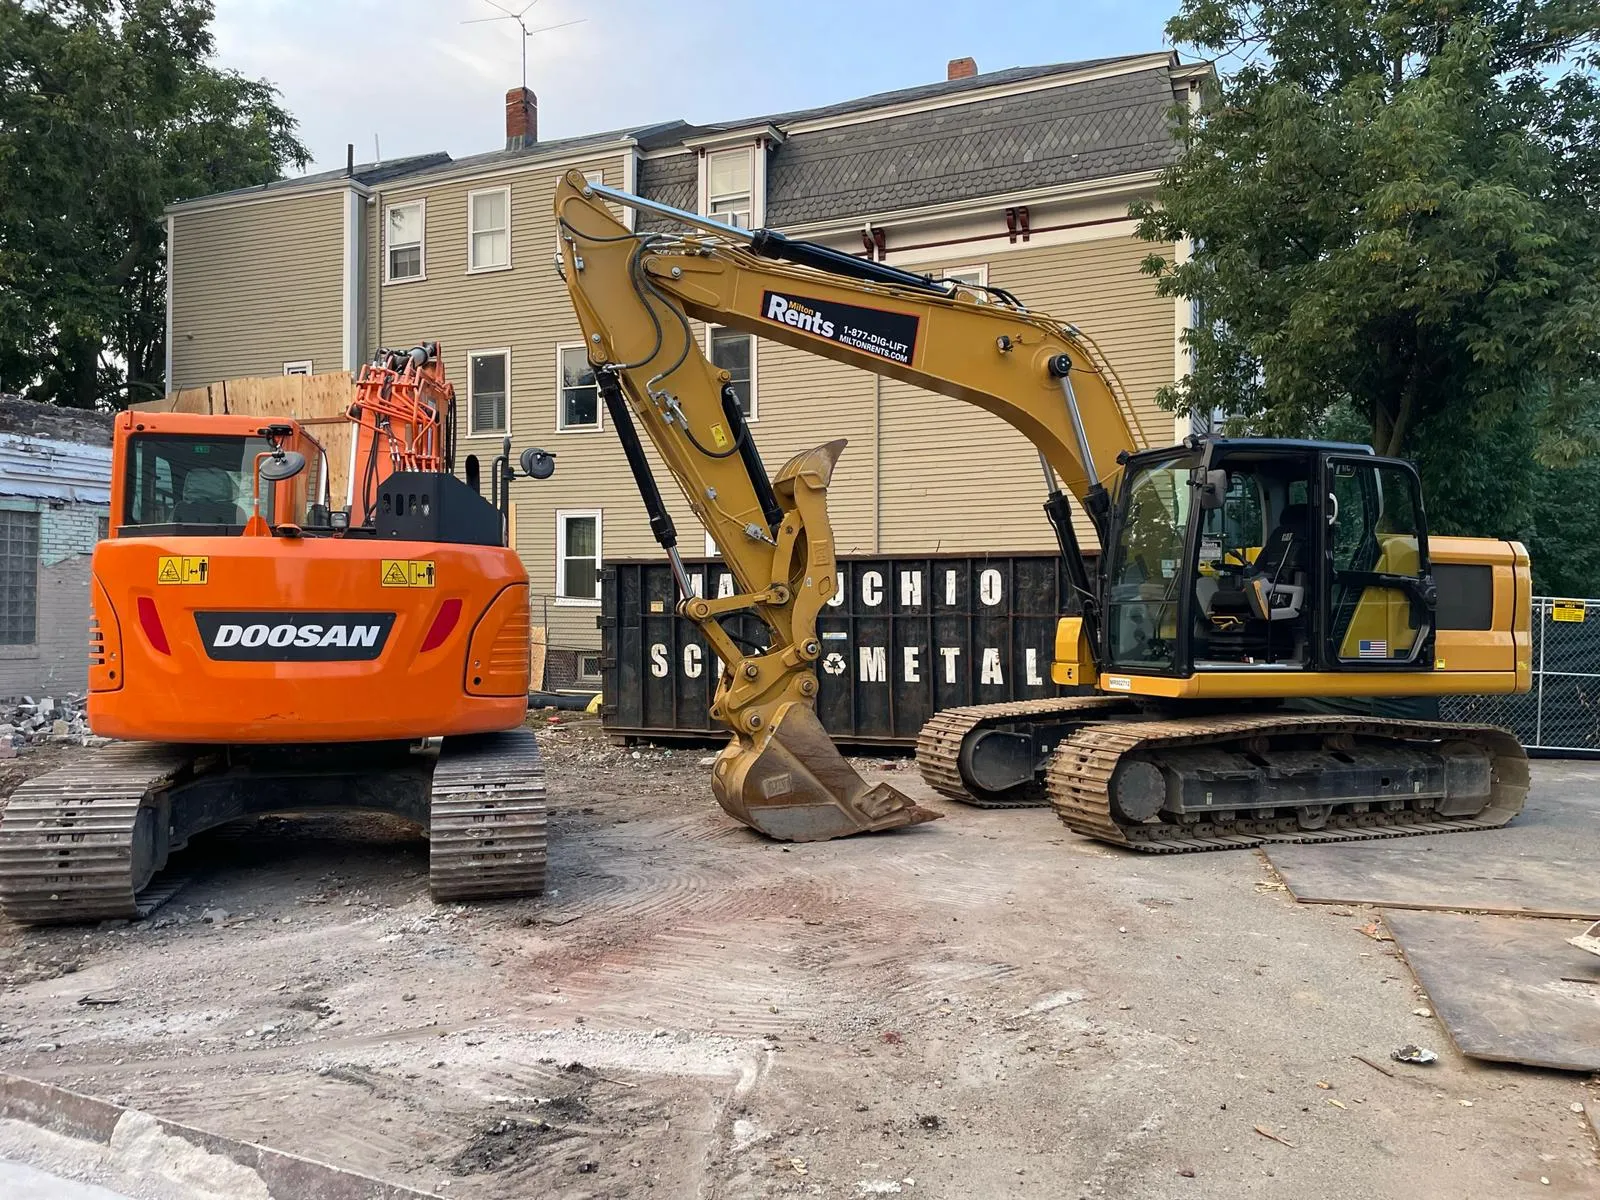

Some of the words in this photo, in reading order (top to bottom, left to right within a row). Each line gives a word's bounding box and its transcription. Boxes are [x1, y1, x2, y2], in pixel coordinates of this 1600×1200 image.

[767, 294, 835, 338] Rents
[788, 301, 814, 315] Milton
[839, 334, 908, 363] MILTONRENTS.COM
[843, 325, 909, 354] 1-877-DIG-LIFT
[213, 624, 381, 648] DOOSAN
[859, 646, 1043, 685] METAL
